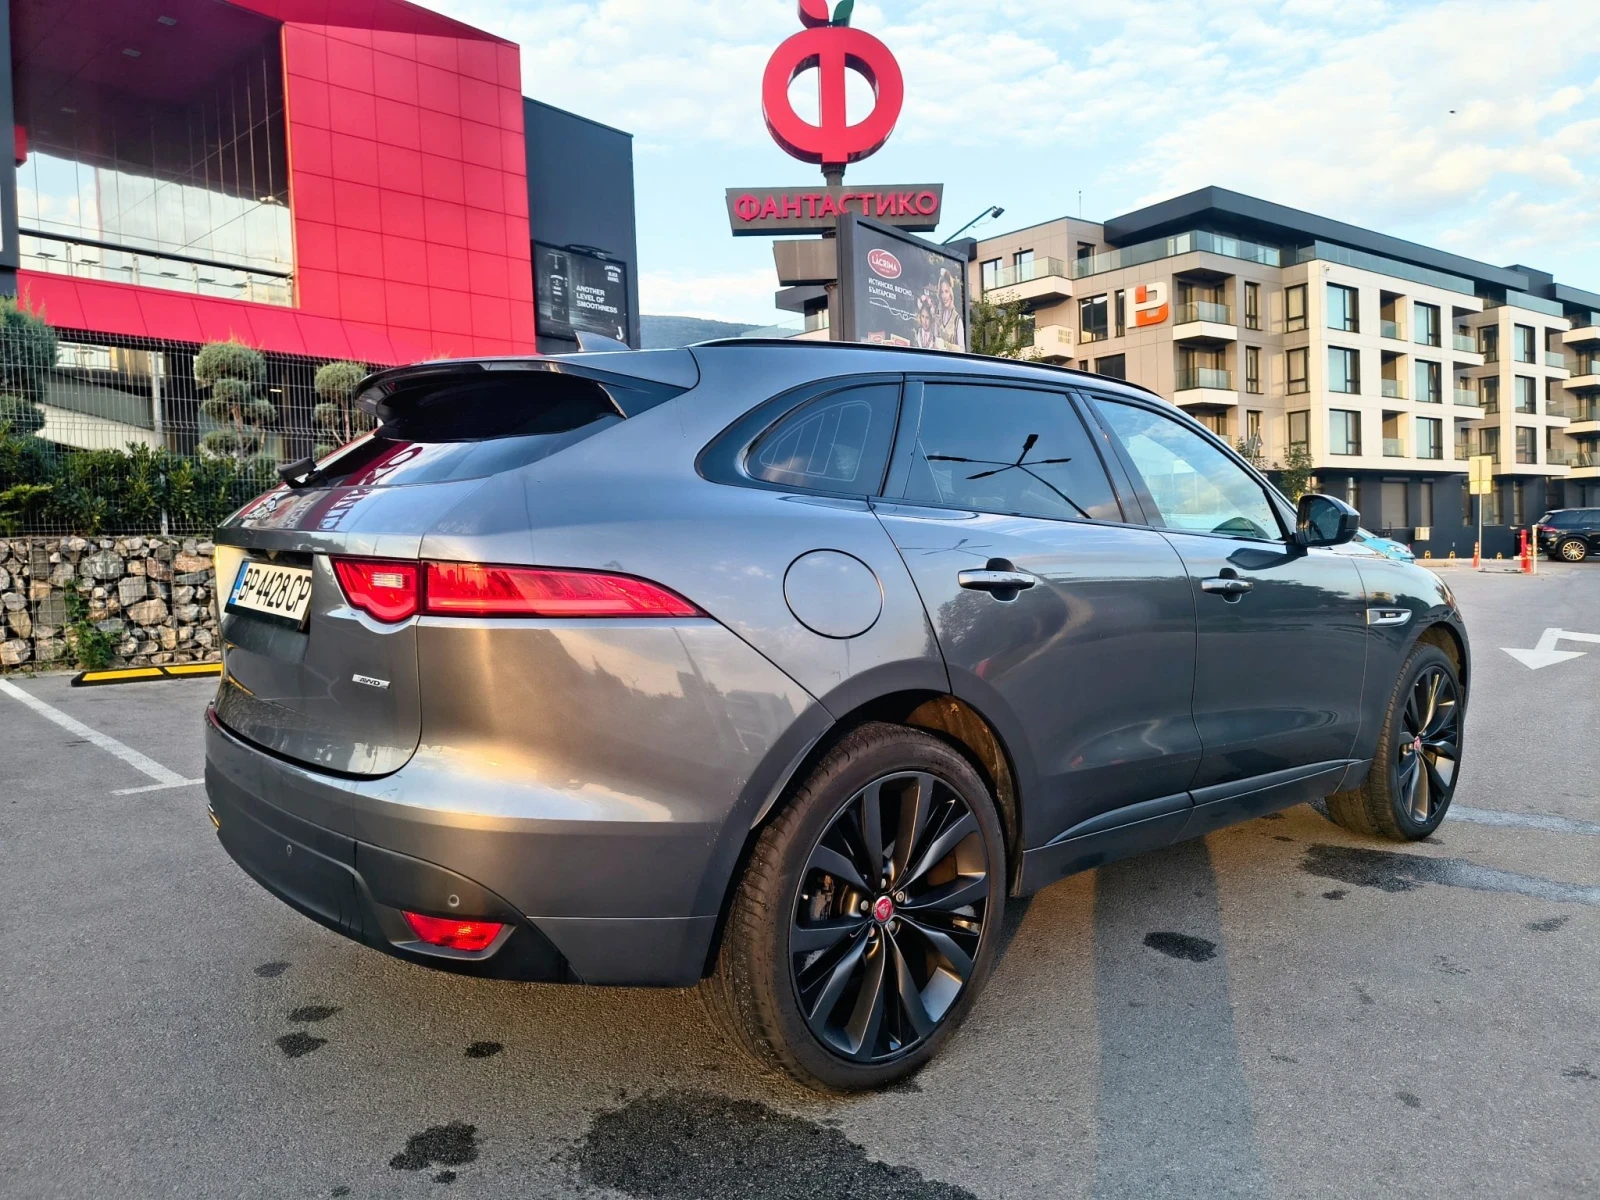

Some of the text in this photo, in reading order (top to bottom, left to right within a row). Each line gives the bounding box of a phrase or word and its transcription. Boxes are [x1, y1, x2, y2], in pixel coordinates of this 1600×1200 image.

[734, 190, 938, 222] ФАНТАСТИКО
[576, 285, 605, 296] ANOTHER
[576, 292, 595, 302] LEVEL
[576, 300, 617, 313] SMOOTHNESS
[256, 571, 291, 608] 4428
[359, 677, 381, 686] AWD
